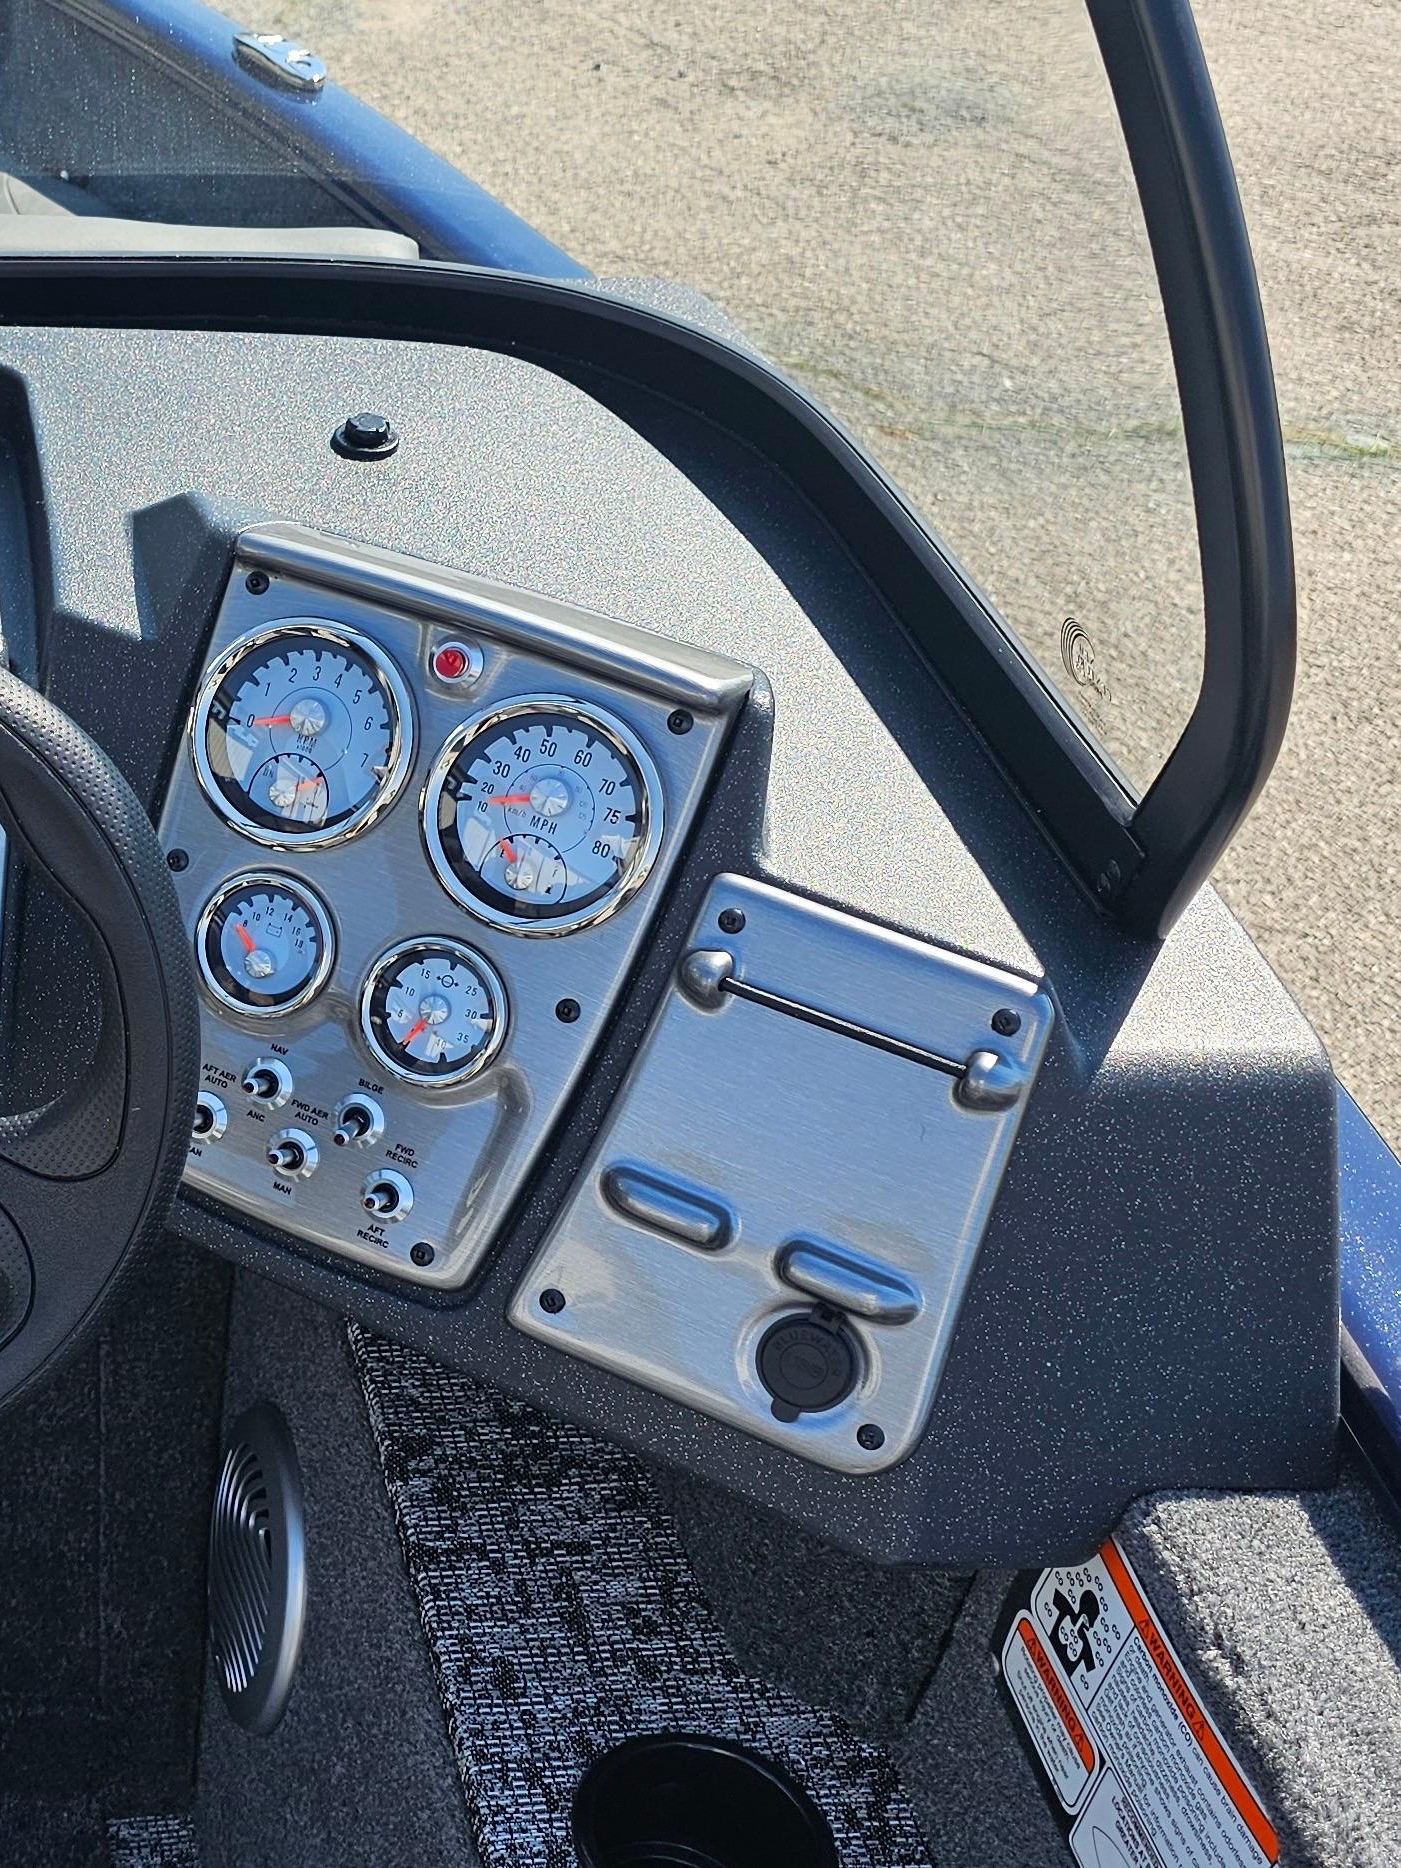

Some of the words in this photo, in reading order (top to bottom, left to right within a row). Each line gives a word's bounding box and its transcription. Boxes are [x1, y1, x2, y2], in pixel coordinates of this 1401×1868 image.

[289, 668, 297, 683] 2
[313, 666, 322, 681] 3
[334, 673, 343, 688] 4
[265, 683, 271, 696] 1
[353, 689, 362, 704] 5
[247, 714, 255, 728] 0
[364, 716, 373, 730] 6
[296, 733, 318, 748] RPM
[514, 745, 531, 763] 40
[539, 739, 557, 758] 50
[361, 753, 369, 768] 7
[574, 749, 592, 767] 60
[493, 761, 510, 779] 30
[481, 782, 495, 795] 20
[598, 778, 615, 796] 70
[477, 800, 488, 813] 10
[603, 807, 621, 825] 75
[529, 815, 558, 835] MPH
[592, 840, 610, 858] 80
[252, 911, 261, 921] 10
[265, 906, 274, 916] 12
[284, 913, 293, 923] 14
[292, 926, 301, 936] 16
[294, 939, 303, 948] 18
[421, 968, 431, 980] 15
[405, 986, 415, 997] 10
[465, 985, 477, 996] 25
[465, 1009, 477, 1019] 30
[457, 1032, 469, 1043] 35
[270, 1043, 289, 1056] NAV
[202, 1063, 220, 1078] AFT
[218, 1069, 237, 1083] AER
[204, 1074, 229, 1089] AUTO
[358, 1078, 384, 1095] BILGE
[246, 1109, 265, 1122] ANC
[290, 1098, 311, 1113] FWD
[309, 1105, 329, 1120] AER
[294, 1110, 319, 1126] AUTO
[188, 1145, 203, 1157] AN
[395, 1143, 415, 1157] FWD
[385, 1149, 419, 1169] RECIRC
[272, 1181, 292, 1196] MAN
[367, 1223, 386, 1237] AFT
[357, 1229, 390, 1249] RECIRC
[1055, 1572, 1063, 1586] CO
[1066, 1571, 1075, 1586] CO
[1075, 1572, 1084, 1587] CO
[1083, 1568, 1091, 1582] CO
[1094, 1576, 1103, 1591] CO
[1067, 1589, 1076, 1603] CO
[1044, 1602, 1052, 1617] CO
[1099, 1597, 1108, 1612] CO
[1100, 1617, 1110, 1633] CO
[1111, 1624, 1120, 1640] CO
[1060, 1627, 1069, 1641] CO
[1069, 1628, 1078, 1644] CO
[1092, 1631, 1101, 1647] CO
[1068, 1641, 1078, 1657] CO
[1102, 1638, 1111, 1653] CO
[1095, 1652, 1104, 1667] CO
[1080, 1675, 1089, 1690] CO
[1147, 1631, 1196, 1721] WARNING
[1033, 1649, 1078, 1733] WARNING
[1123, 1651, 1142, 1686] Engine
[1141, 1683, 1152, 1703] and
[1151, 1702, 1176, 1749] generator
[1176, 1747, 1197, 1787] exhaust
[1196, 1784, 1221, 1831] contains
[1133, 1635, 1153, 1673] Carbon
[1152, 1671, 1178, 1721] monoxide
[1178, 1720, 1192, 1747] (CO)
[1192, 1746, 1203, 1766] can
[1203, 1764, 1221, 1797] cause
[1220, 1793, 1237, 1824] brain
[1236, 1819, 1262, 1868] damage
[1151, 1718, 1170, 1753] carbon
[1169, 1751, 1196, 1801] monoxide
[1135, 1702, 1154, 1738] carbon
[1153, 1736, 1179, 1785] monoxide
[1177, 1782, 1205, 1834] poisoning
[1110, 1795, 1140, 1850] LOCATIONS
[1138, 1847, 1146, 1863] AT
[1180, 1804, 1213, 1866] drowsiness,
[1114, 1818, 1139, 1865] GREATER
